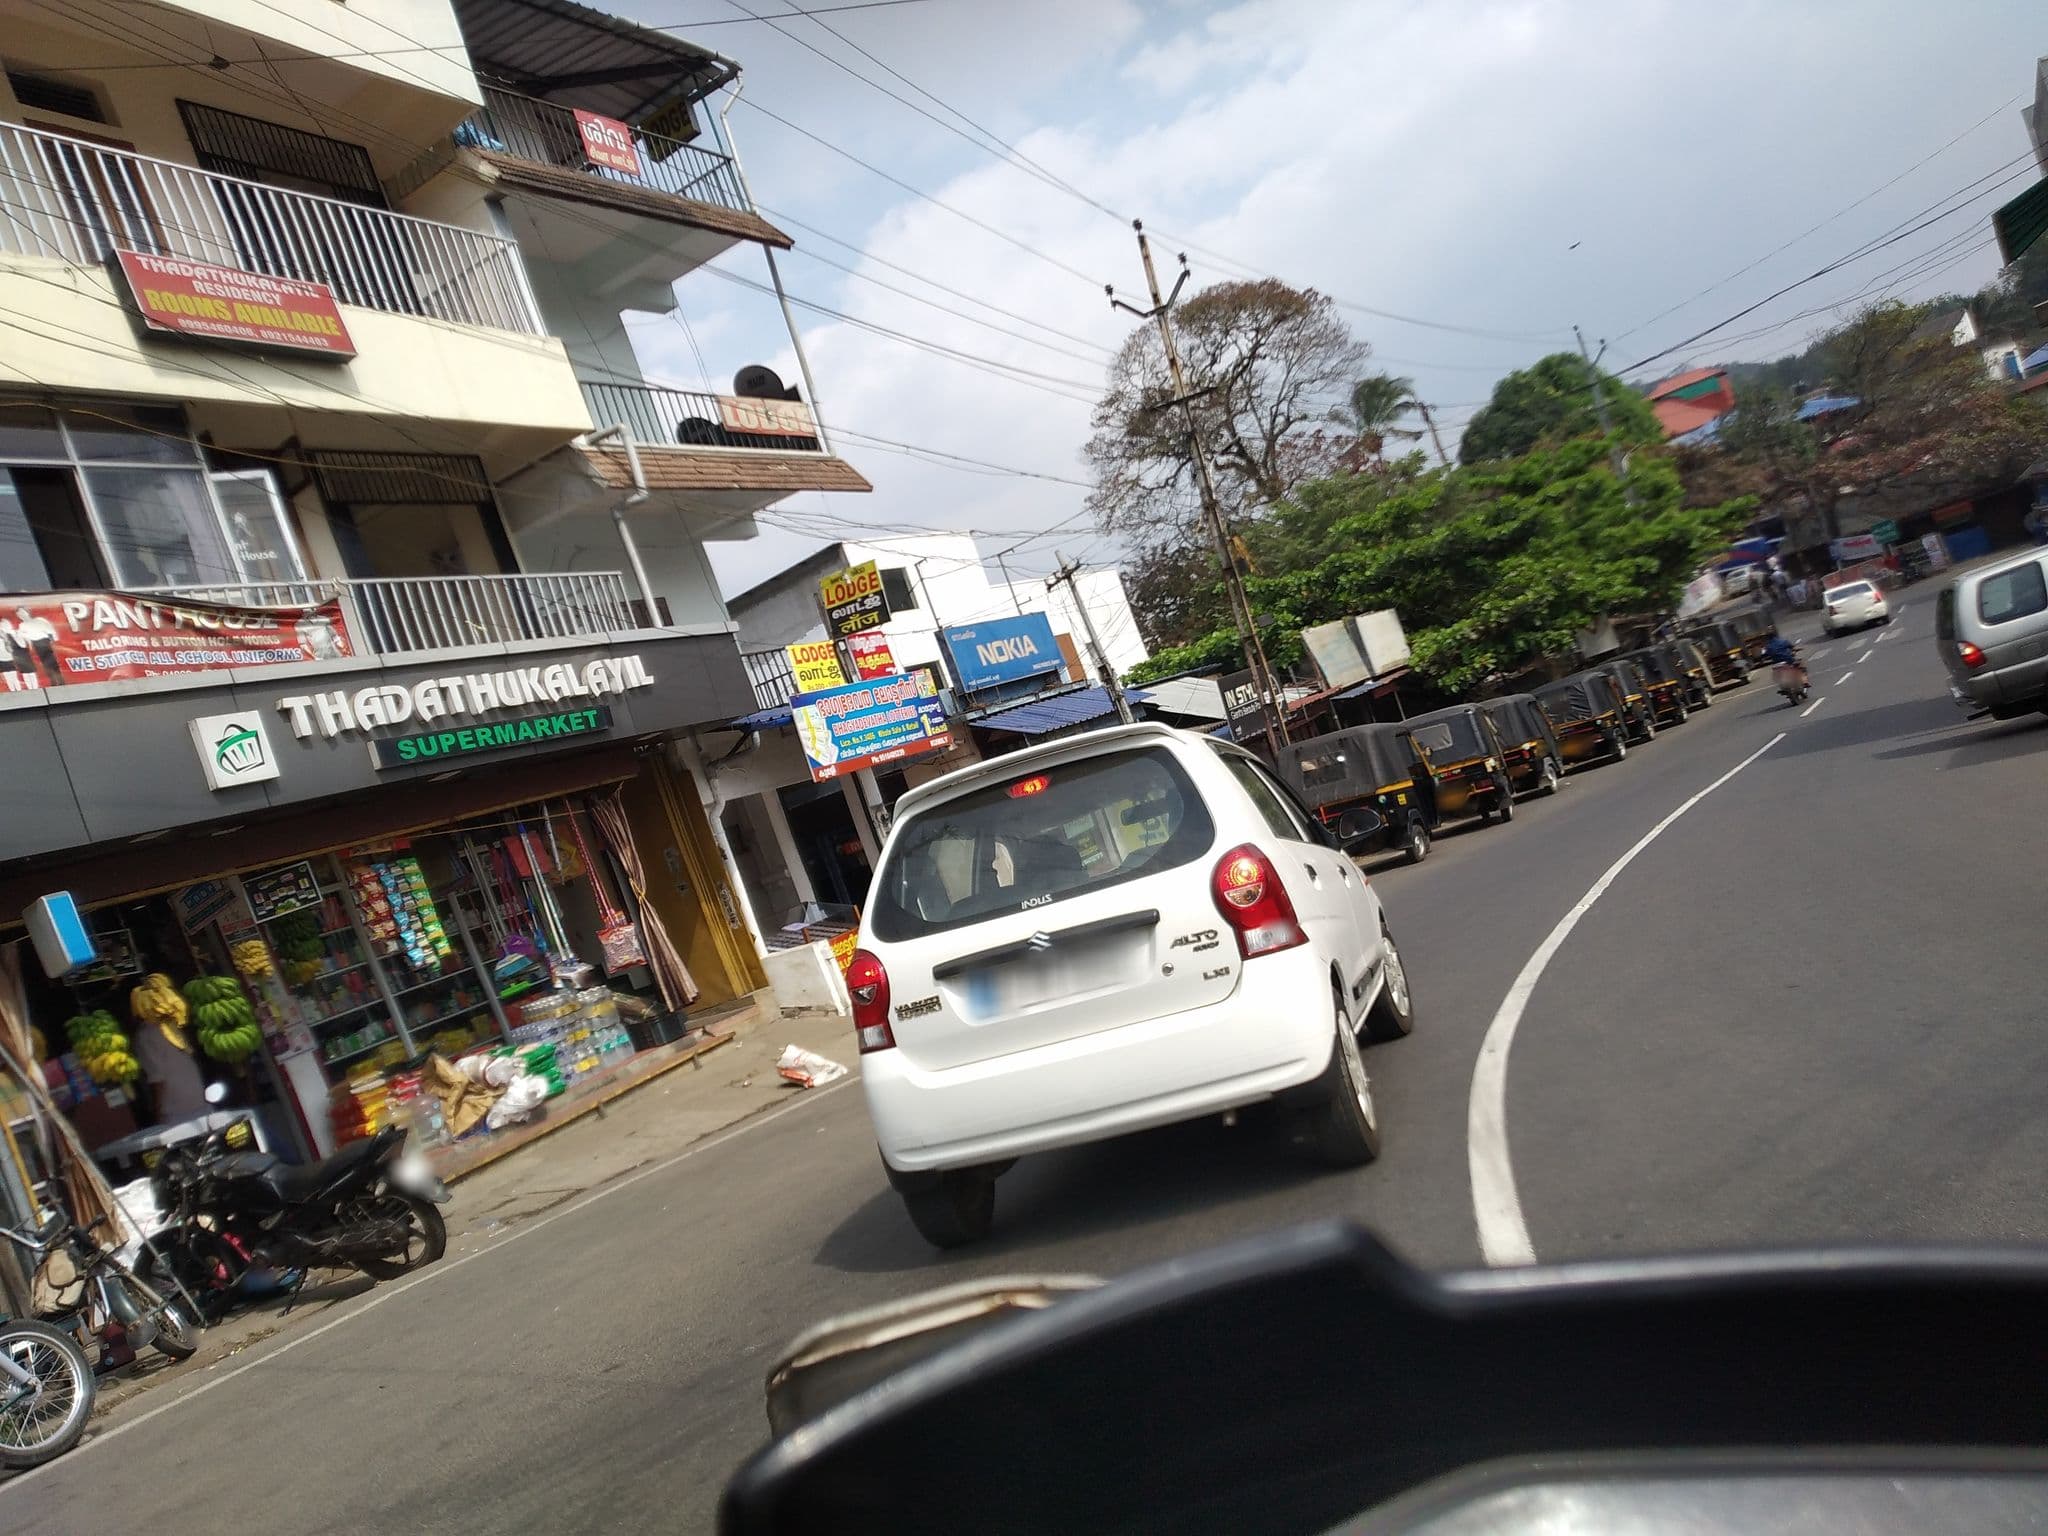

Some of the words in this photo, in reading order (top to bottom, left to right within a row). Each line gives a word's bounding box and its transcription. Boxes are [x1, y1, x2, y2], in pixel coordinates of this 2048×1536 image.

[136, 256, 319, 298] THADATHUKALAYIL
[192, 280, 282, 306] RESIDENCY
[143, 289, 233, 322] ROOMS
[233, 302, 342, 336] AVAILABLE
[825, 571, 880, 605] LODGE
[63, 600, 162, 633] PANT
[82, 635, 148, 651] TAILORING
[151, 636, 159, 648] &
[162, 636, 205, 648] BUTTON
[241, 634, 281, 647] WORKS
[791, 643, 836, 665] LODGE
[976, 634, 1040, 667] NOKIA
[66, 655, 95, 673] WE
[96, 651, 149, 669] STITCH
[150, 651, 176, 666] ALL
[176, 650, 232, 664] SCHOOL
[233, 648, 304, 666] UNIFORMS
[800, 660, 841, 682] லாட்ஜ்
[276, 655, 655, 739] THADATHUKALAYIL
[1224, 689, 1237, 709] IN
[1235, 683, 1259, 705] STYL
[396, 709, 601, 760] SUPERMARKET
[1020, 893, 1053, 910] INDUS
[1170, 928, 1219, 950] ALTO
